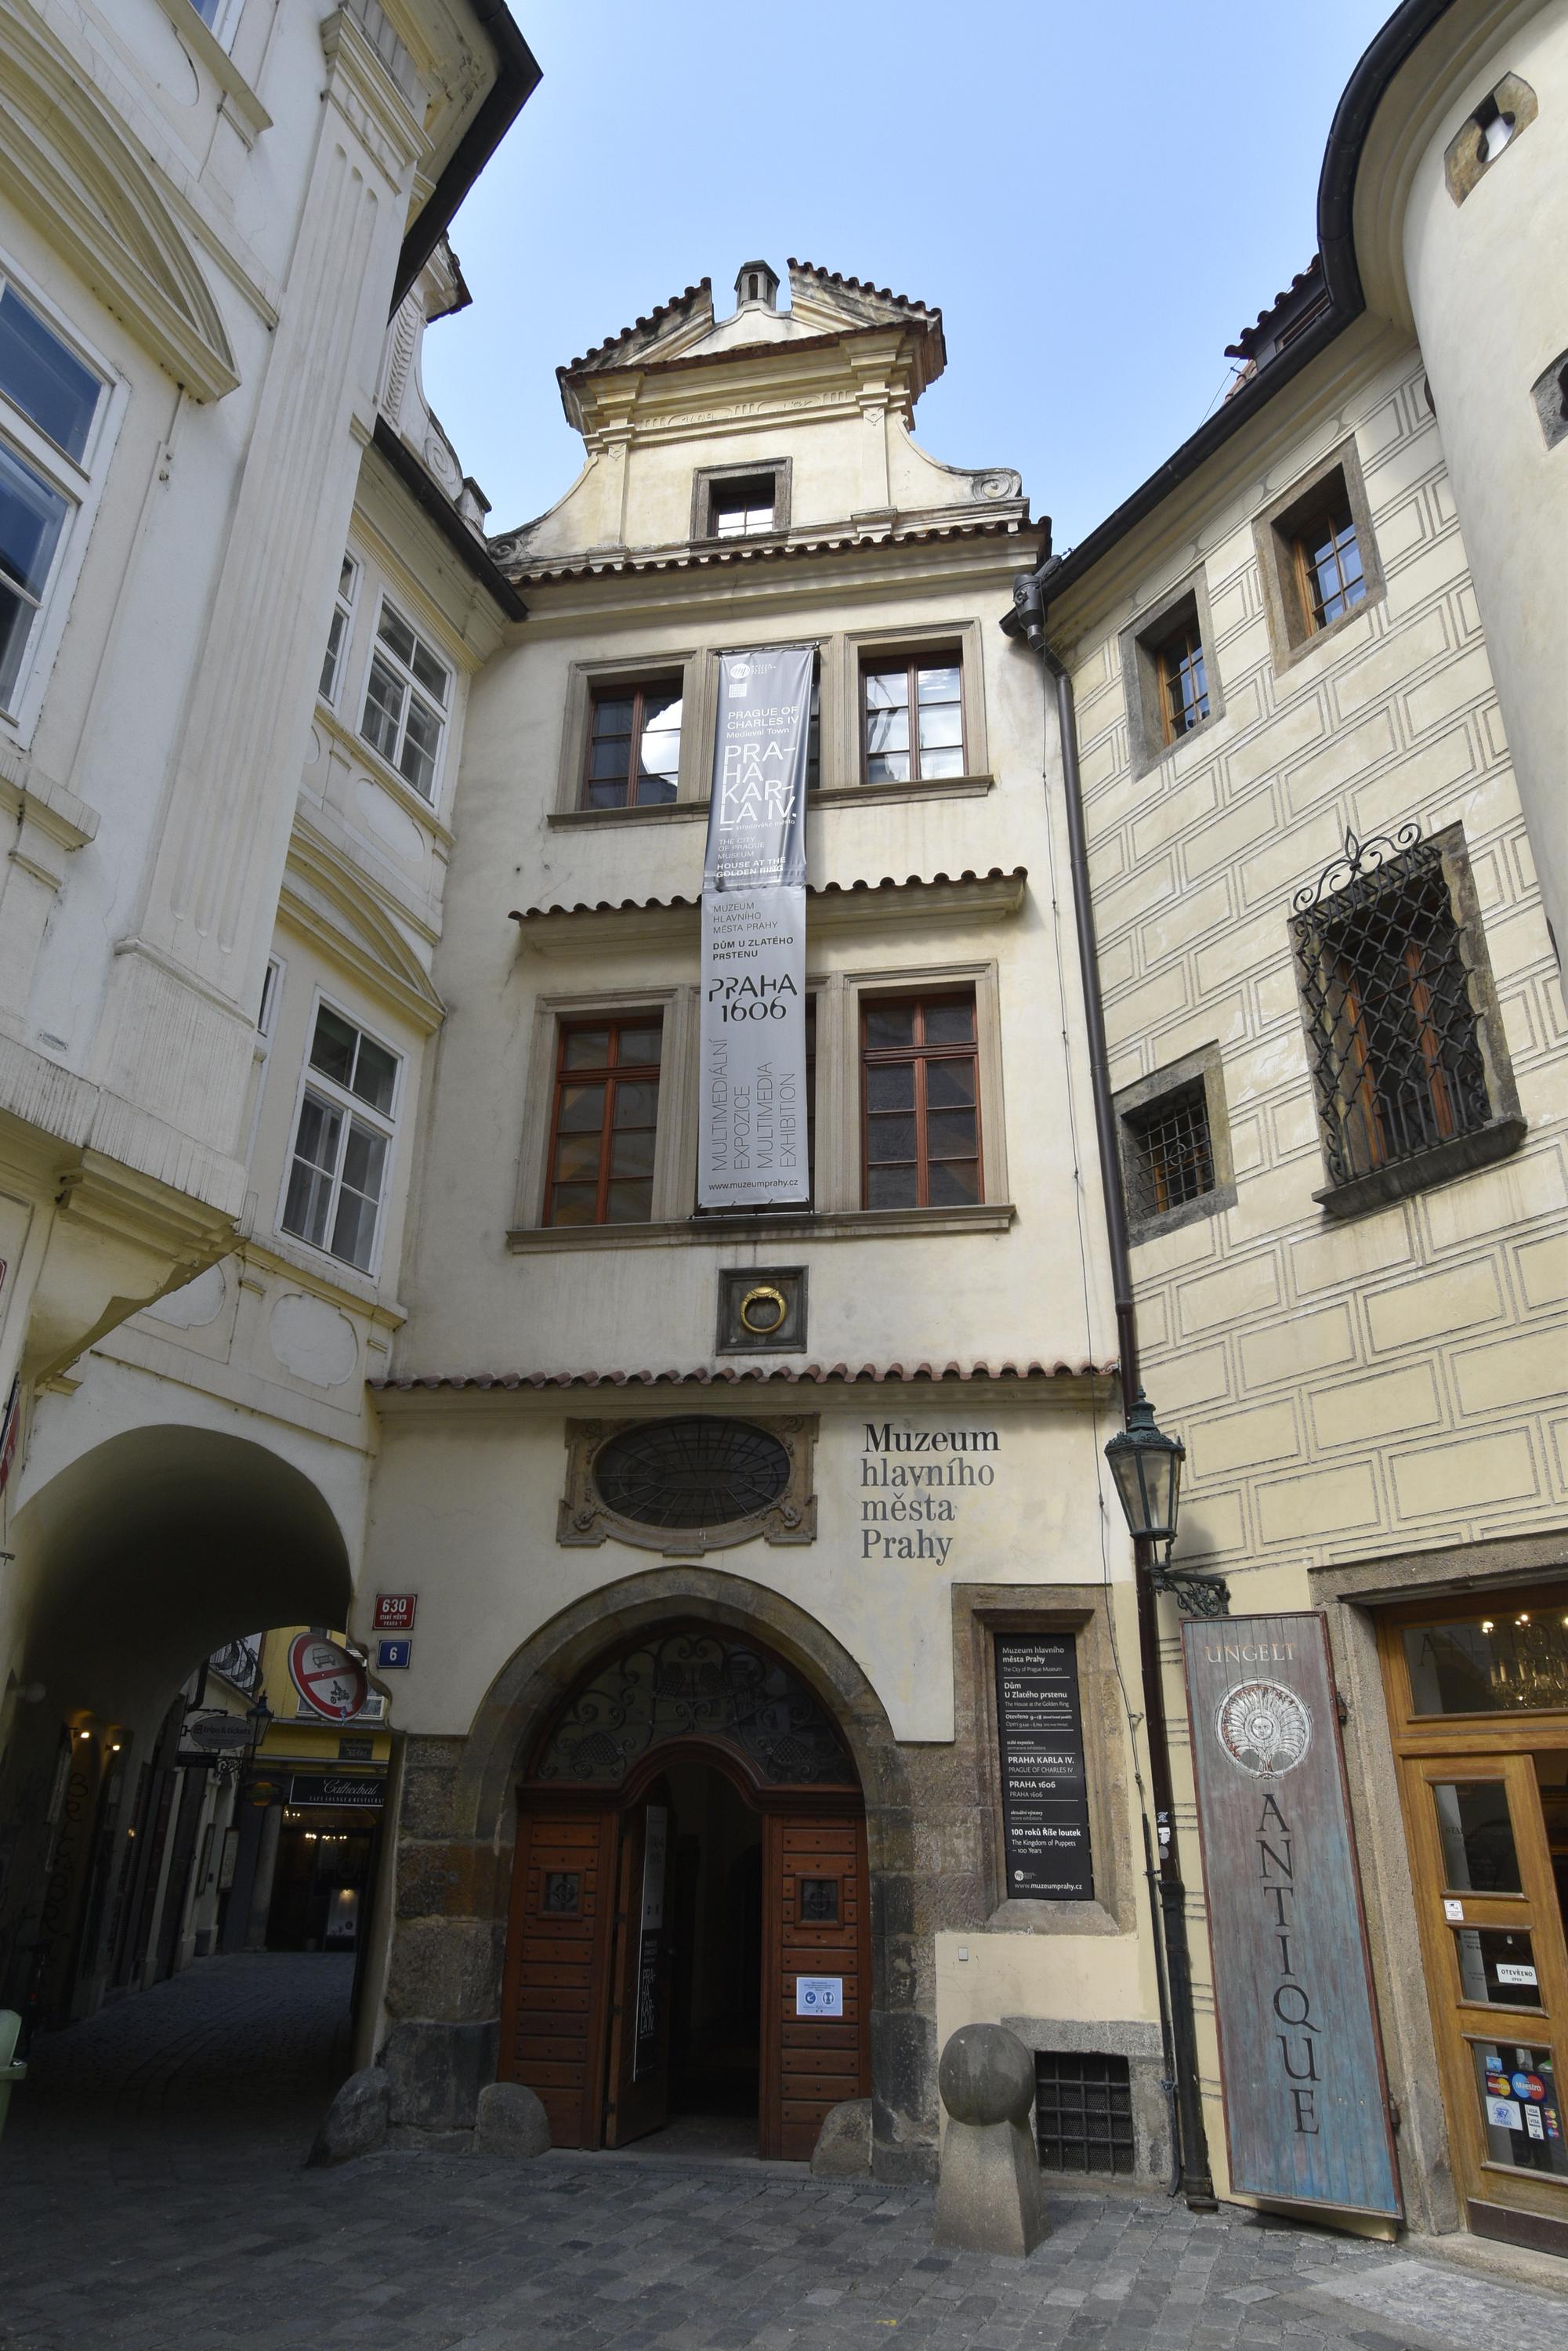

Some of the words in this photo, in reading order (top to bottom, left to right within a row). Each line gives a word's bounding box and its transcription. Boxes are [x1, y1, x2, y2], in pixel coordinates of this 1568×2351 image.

[728, 708, 777, 719] PRAGUE
[781, 706, 798, 715] OF
[727, 717, 784, 730] CHARLES
[788, 715, 799, 724] IV
[726, 729, 764, 738] Medieval
[724, 741, 796, 765] PRA-
[723, 763, 764, 784] HA
[722, 780, 794, 804] KAR-
[720, 802, 758, 824] LA
[768, 796, 797, 820] IV.
[732, 842, 765, 850] PRAGUE
[717, 851, 755, 860] MUSEUM
[716, 868, 756, 878] GOLDEN
[759, 864, 784, 874] RING
[717, 861, 751, 870] HOUSE
[713, 903, 755, 912] MUZEUM
[713, 911, 762, 923] HLAVNÍHO
[713, 923, 744, 934] MĚSTA
[747, 921, 778, 931] PRAHY
[713, 940, 735, 950] DŮM
[748, 936, 794, 947] ZLATÉHO
[713, 950, 758, 961] PRSTENU
[708, 973, 798, 1002] PRAHA
[722, 996, 787, 1023] 1606
[708, 1038, 728, 1171] MULTIMEDIÁLNÍ
[757, 1062, 773, 1168] MULTIMEDIA
[780, 1074, 796, 1168] EXHIBITION
[733, 1085, 750, 1169] EXPOZICE
[708, 1179, 798, 1190] www.muzeumprahy.cz
[862, 1423, 1001, 1453] Muzeum
[860, 1457, 994, 1487] hlavního
[861, 1492, 955, 1521] města
[860, 1529, 953, 1567] Prahy
[382, 1599, 407, 1613] 630
[389, 1646, 398, 1661] 6
[1025, 1655, 1045, 1665] Prahy
[1205, 1643, 1296, 1663] UNGELT
[227, 1726, 251, 1735] tickets
[323, 1779, 379, 1795] Cathedral
[1042, 1828, 1057, 1836] Říše
[1014, 1882, 1082, 1891] www.muzeumprahy.cz
[1256, 1794, 1322, 2135] ANTIQUE
[1501, 1968, 1533, 1976] OTEVŘENO
[1515, 2081, 1542, 2092] Maestro
